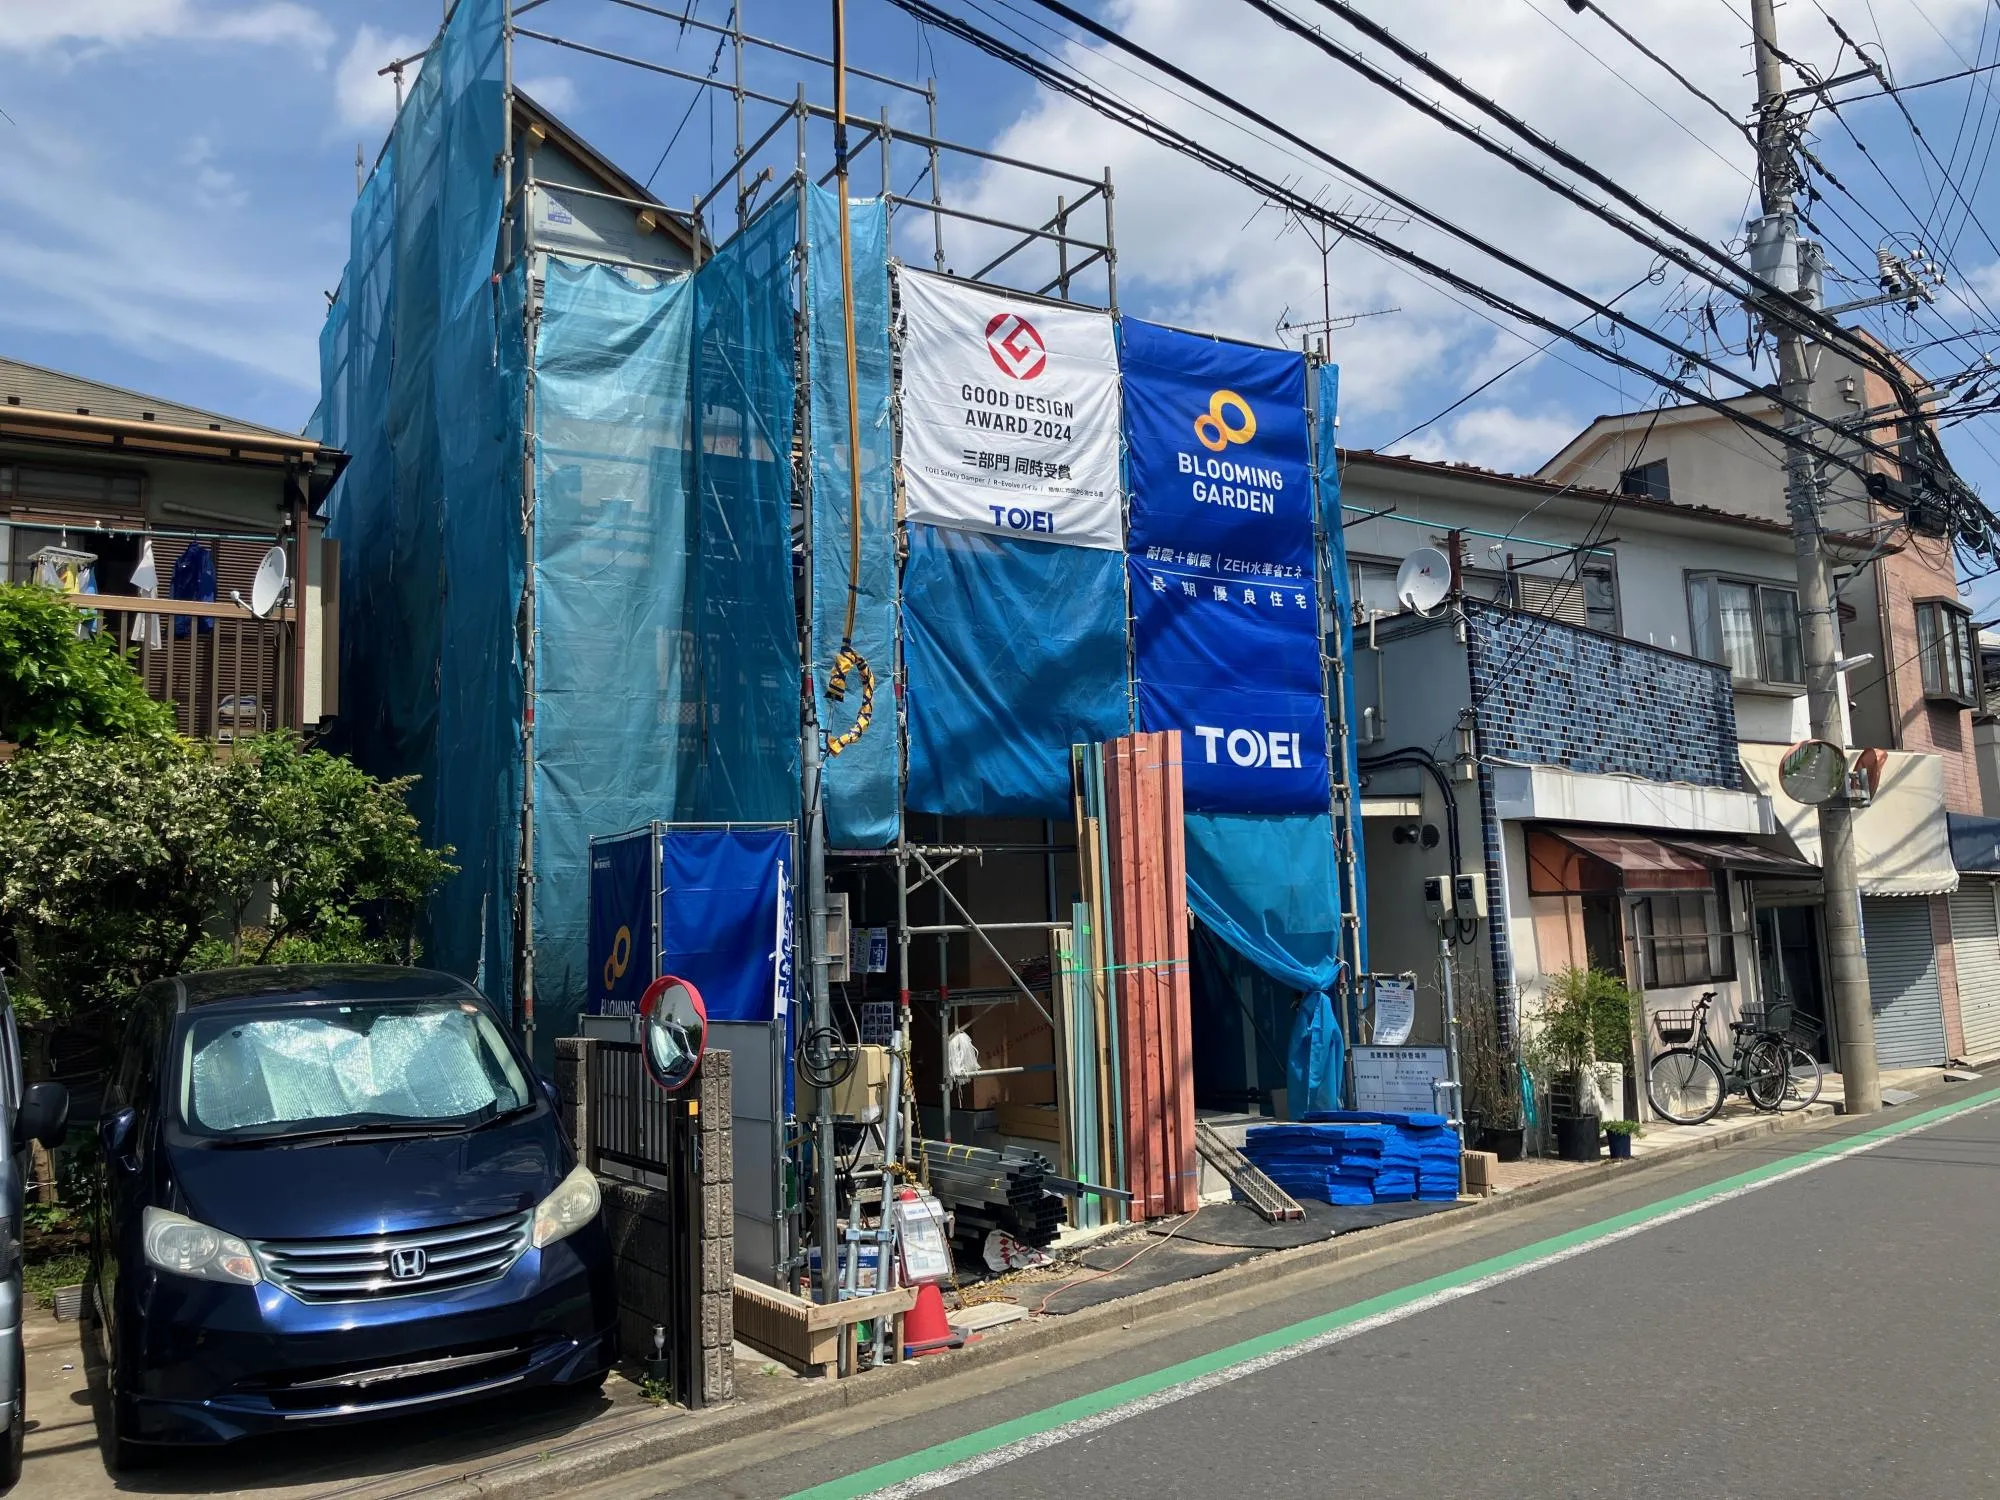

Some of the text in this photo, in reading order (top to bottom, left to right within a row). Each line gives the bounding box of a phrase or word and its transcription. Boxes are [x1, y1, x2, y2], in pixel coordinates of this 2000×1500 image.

[962, 384, 1073, 418] GOOD DESIGN
[965, 409, 1071, 441] AWARD 2024
[941, 470, 959, 479] Safety
[961, 474, 985, 483] Damper
[962, 450, 1072, 480] 三部門 同時受賞
[1178, 452, 1283, 490] BLOOMING
[1193, 481, 1274, 515] GARDEN
[989, 505, 1054, 534] TOEI
[1151, 575, 1307, 609] 長期優良住宅
[1195, 725, 1302, 768] TOEI
